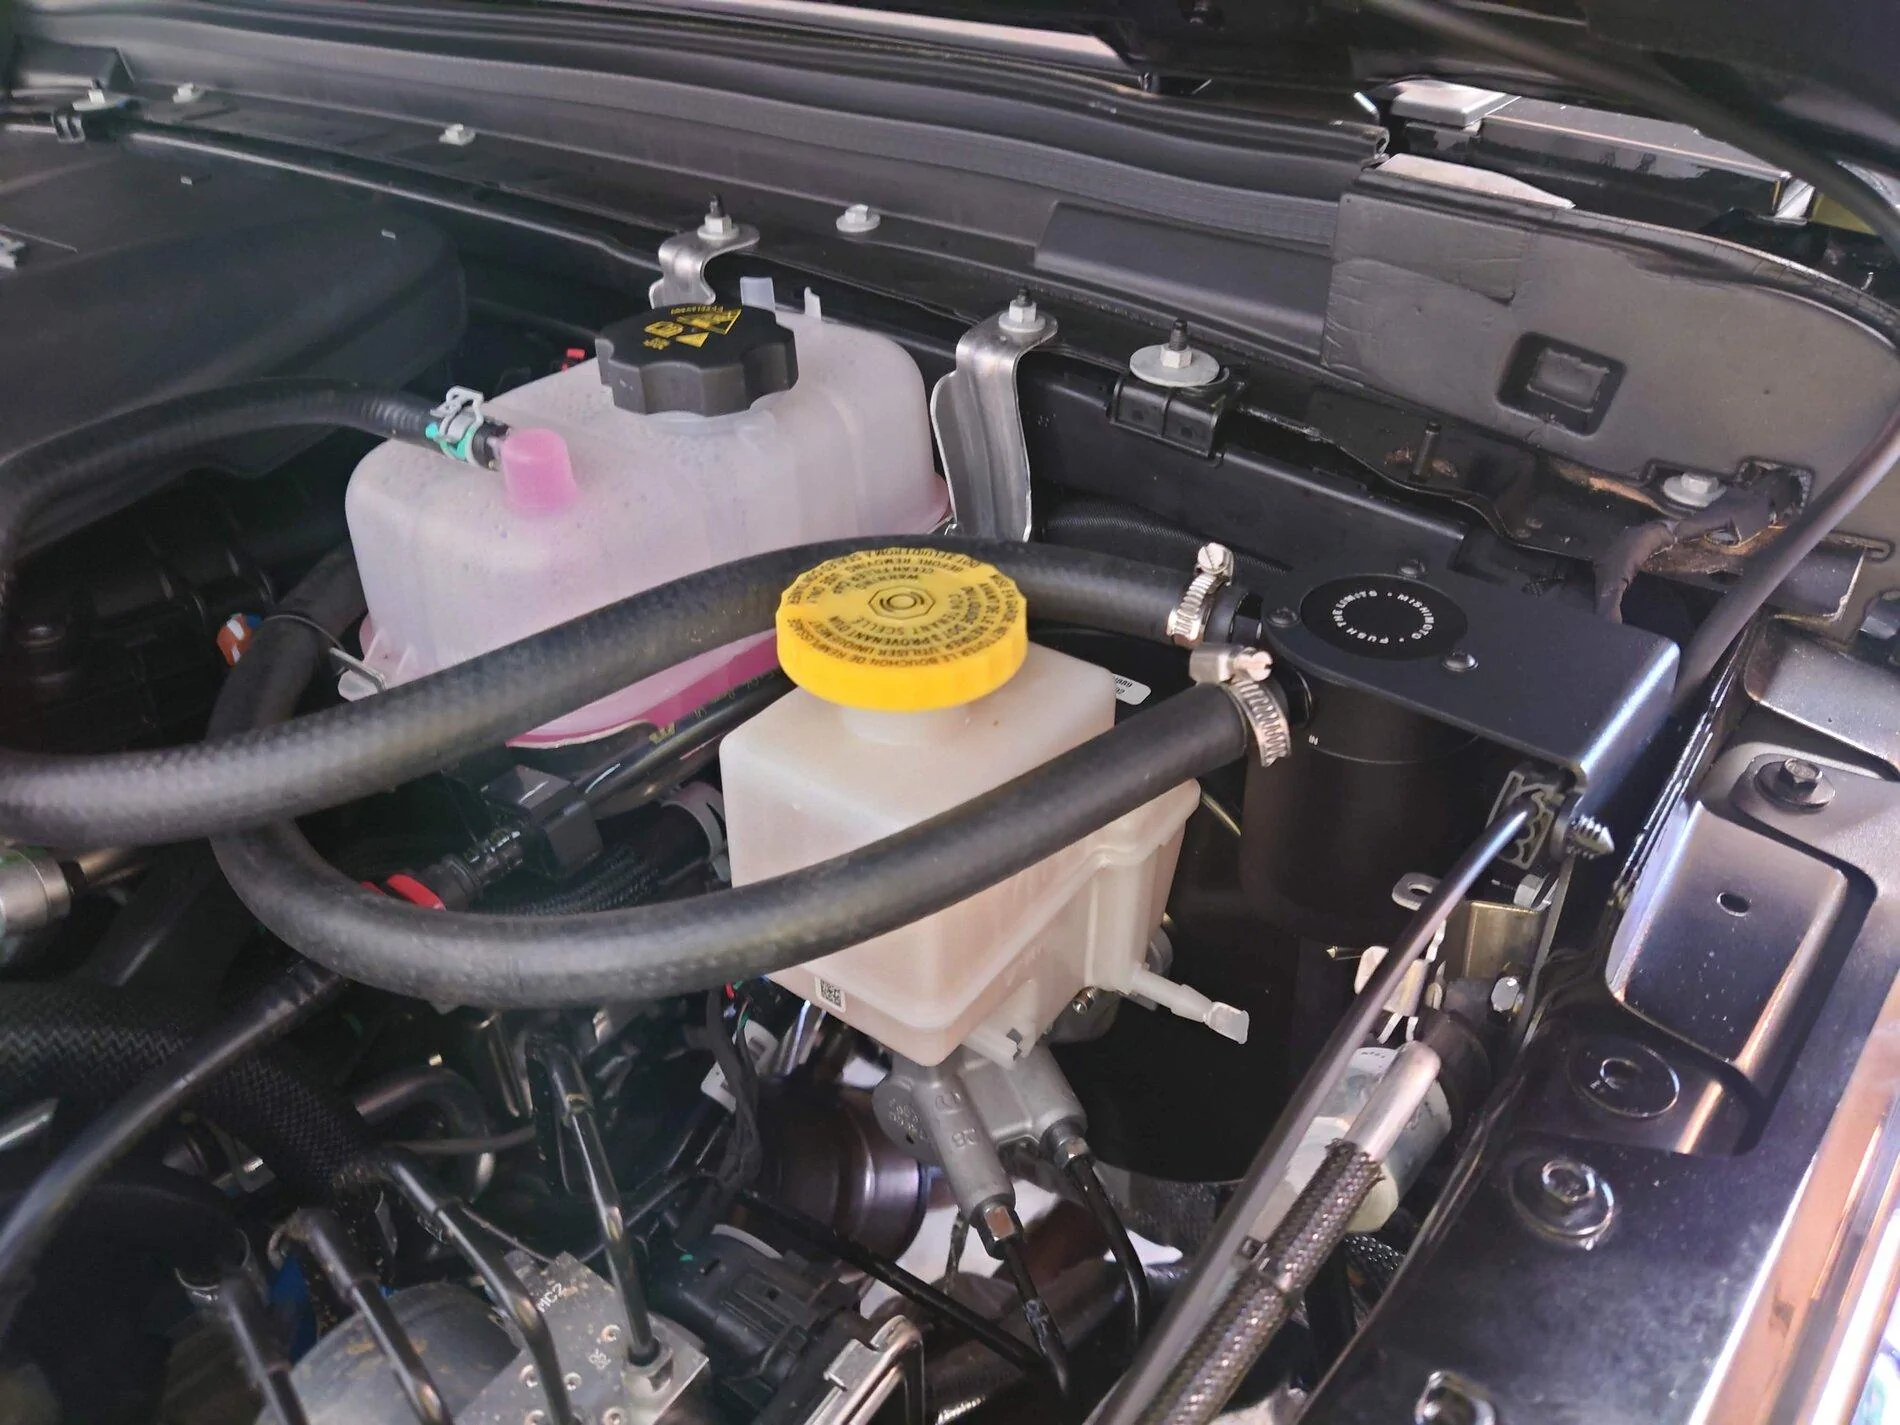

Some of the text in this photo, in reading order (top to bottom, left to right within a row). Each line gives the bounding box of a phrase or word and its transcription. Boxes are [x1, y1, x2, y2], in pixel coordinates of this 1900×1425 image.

[913, 548, 946, 559] FLUID
[893, 566, 935, 575] CLEAN
[919, 559, 964, 573] BEFORE
[1332, 609, 1348, 628] THE
[1397, 594, 1435, 640] MISHIMOTO
[847, 630, 931, 647] PROVENANT
[1346, 627, 1390, 645] PUSH
[878, 648, 940, 657] UTILISER
[851, 655, 867, 665] DE
[870, 657, 938, 667] BOUCHON
[1308, 734, 1319, 746] IN
[535, 1282, 563, 1313] MC2
